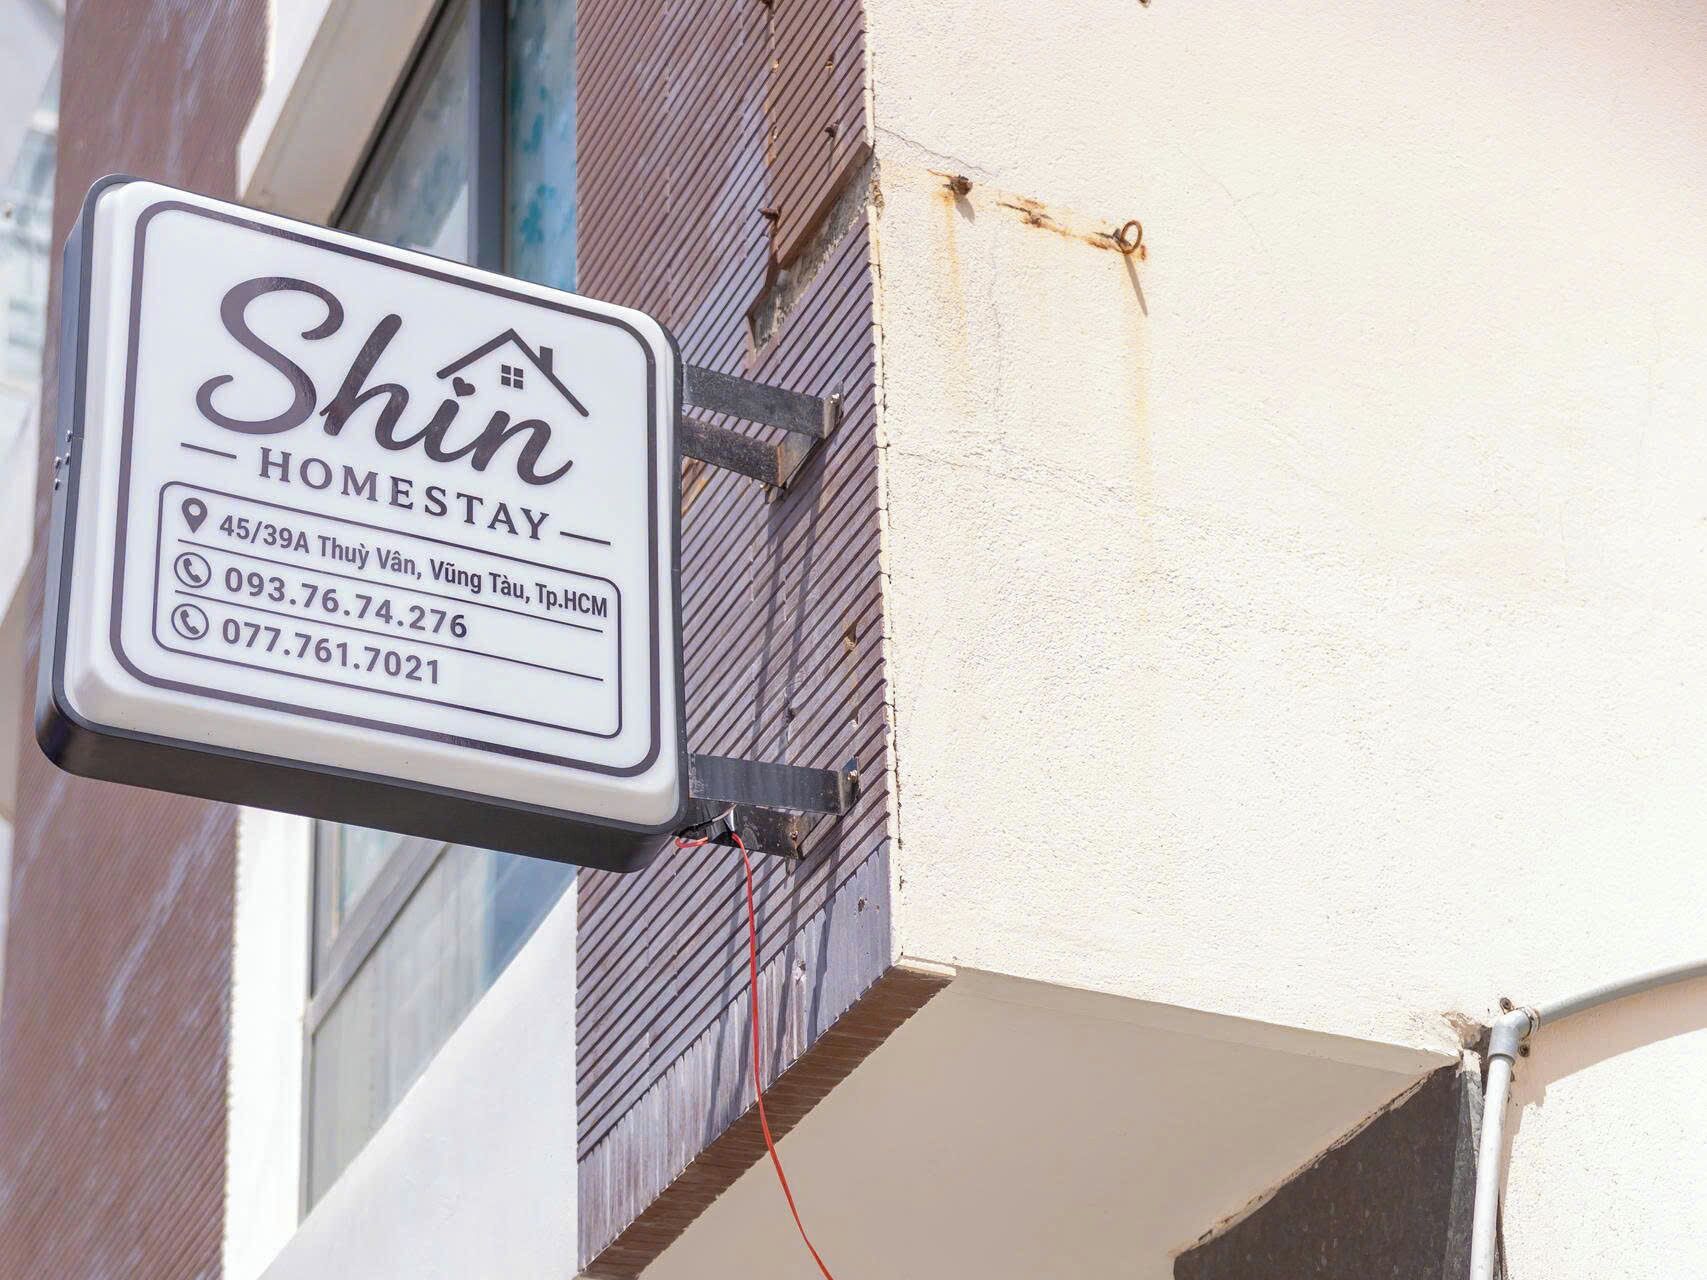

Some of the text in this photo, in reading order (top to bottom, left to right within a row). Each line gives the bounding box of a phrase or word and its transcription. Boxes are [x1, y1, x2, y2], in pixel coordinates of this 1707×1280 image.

[195, 276, 573, 485] Shin
[258, 446, 549, 540] HOMESTAY
[220, 515, 607, 617] 45/39A Thuỳ Vân, Vũng Tàu, Tp.HCM
[225, 567, 467, 637] 093.76.74.276
[222, 619, 438, 684] 077.761.7021
